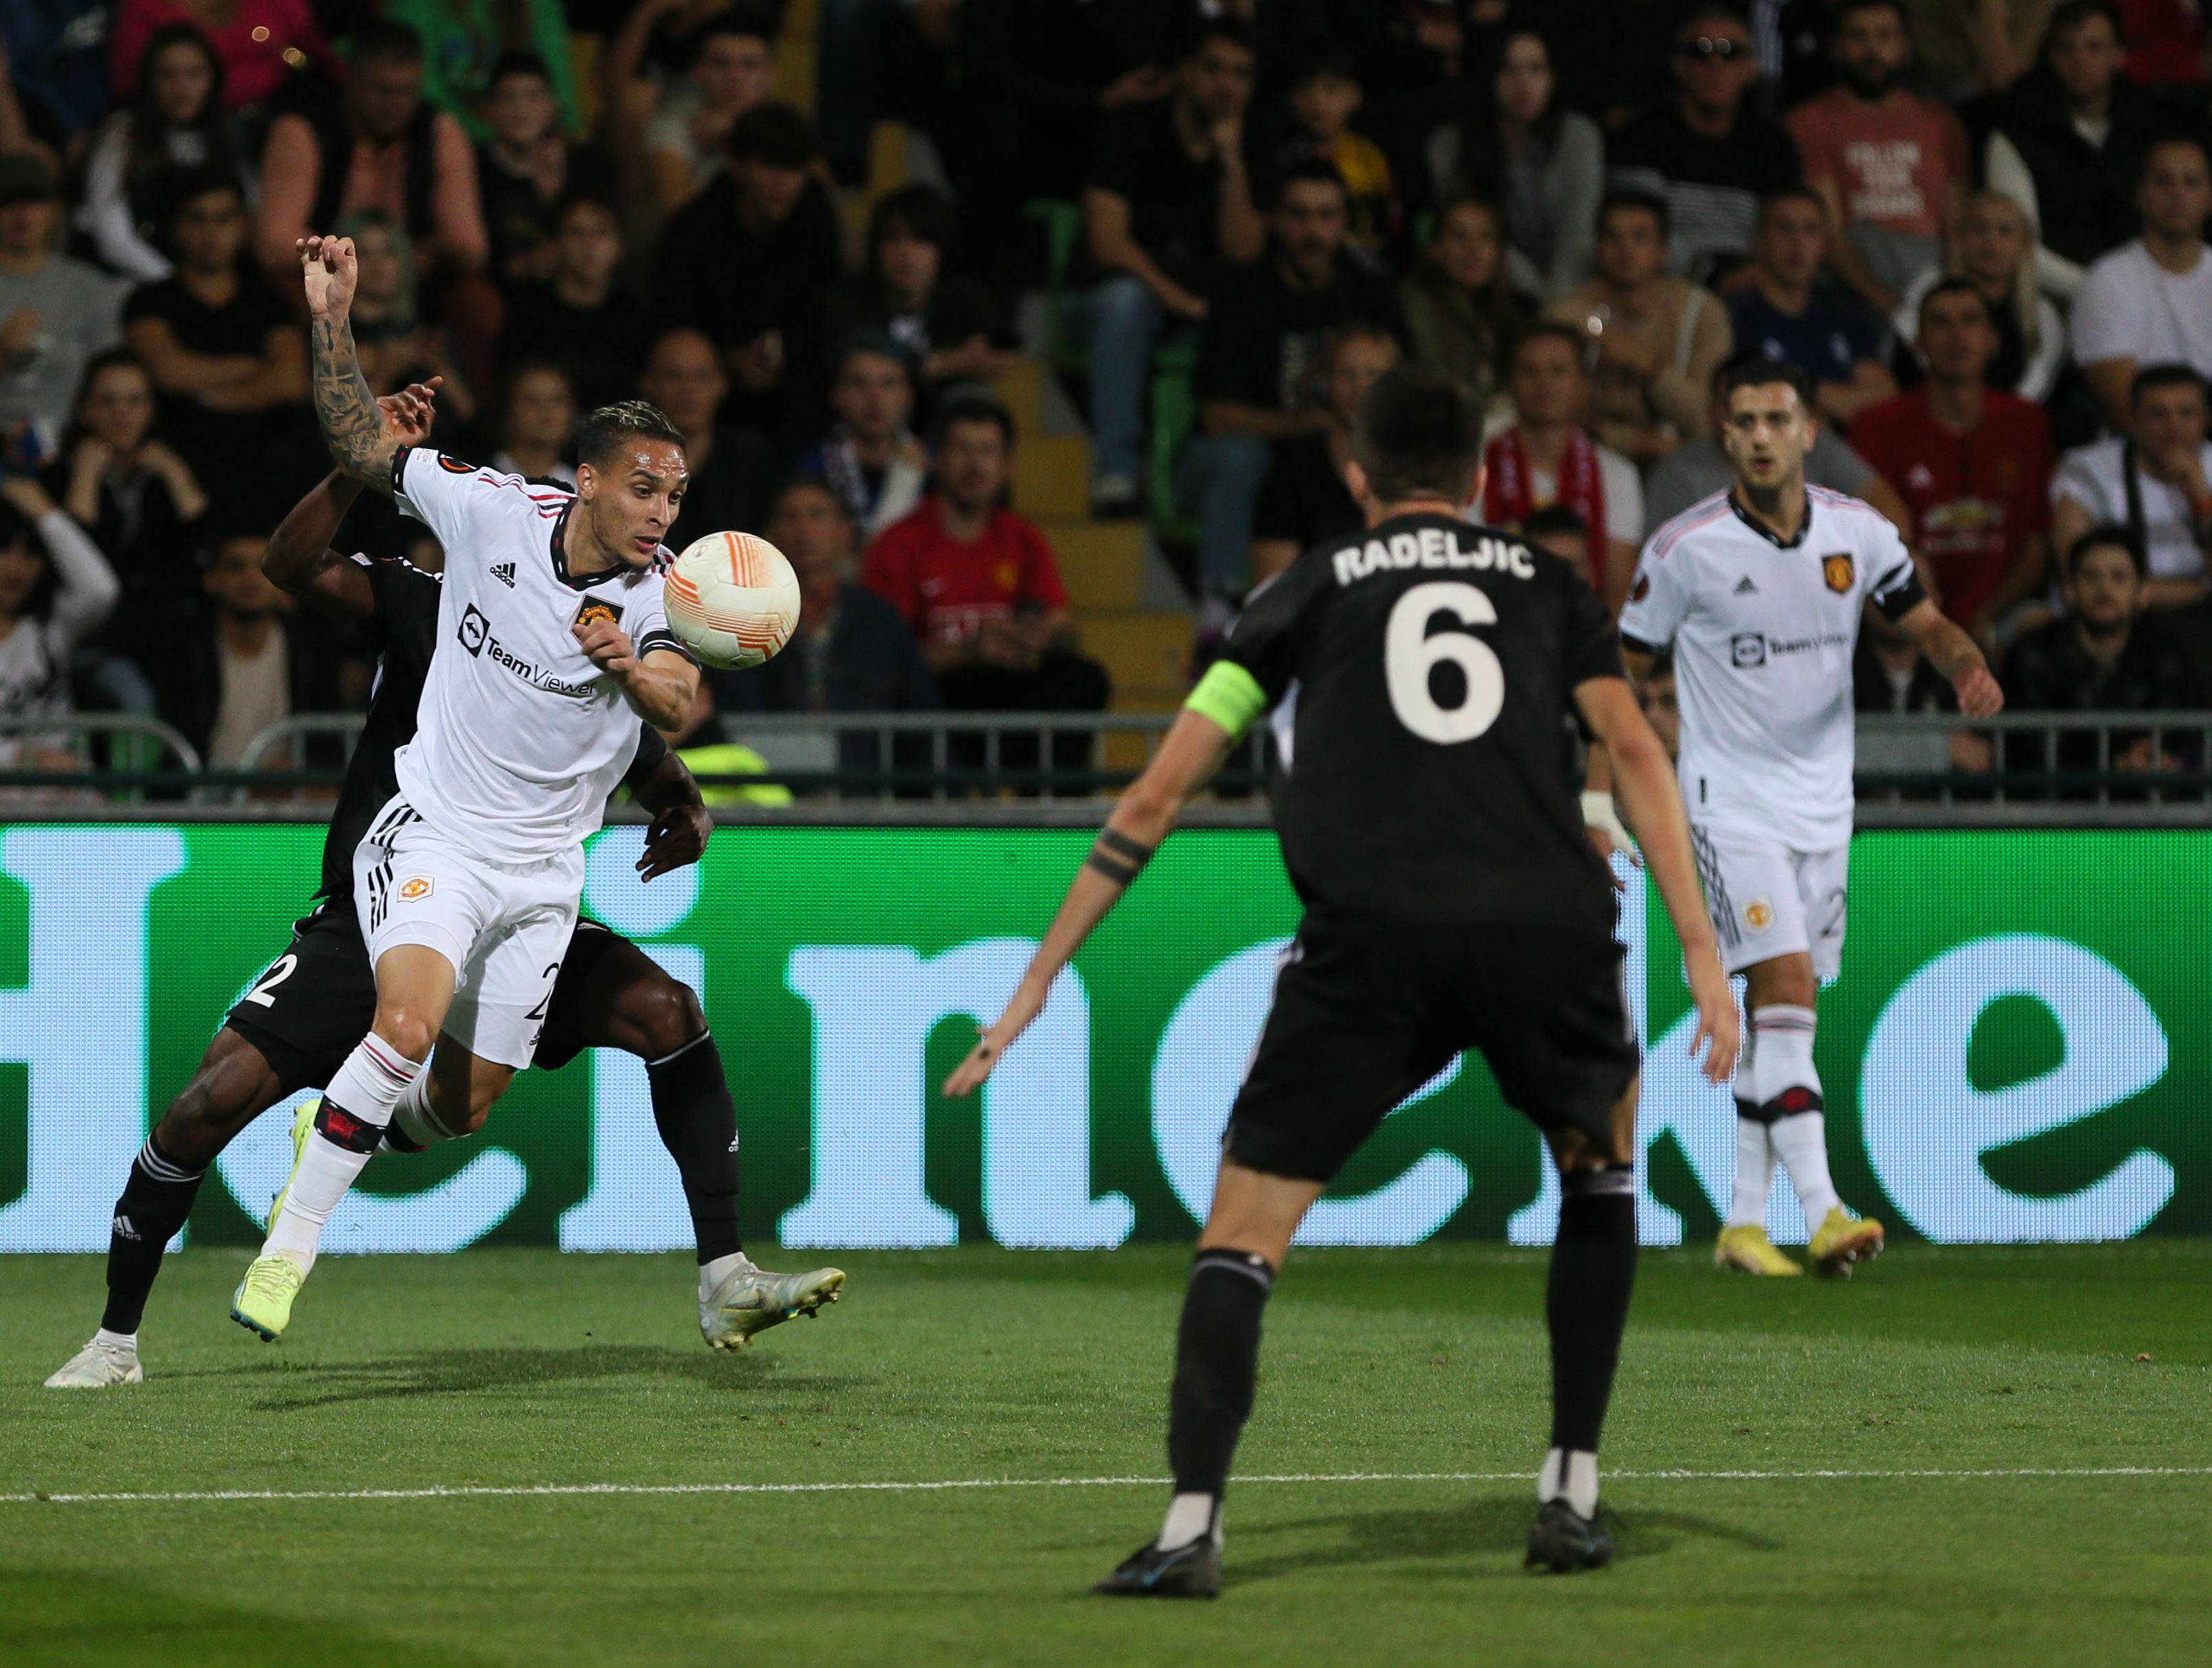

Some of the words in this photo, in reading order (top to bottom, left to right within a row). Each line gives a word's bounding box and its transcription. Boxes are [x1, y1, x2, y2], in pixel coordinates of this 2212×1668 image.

[490, 567, 516, 589] adidas
[1332, 527, 1536, 586] RADELJIC
[487, 637, 597, 694] TeamViewer
[1384, 581, 1505, 745] 6
[245, 953, 298, 1008] 2
